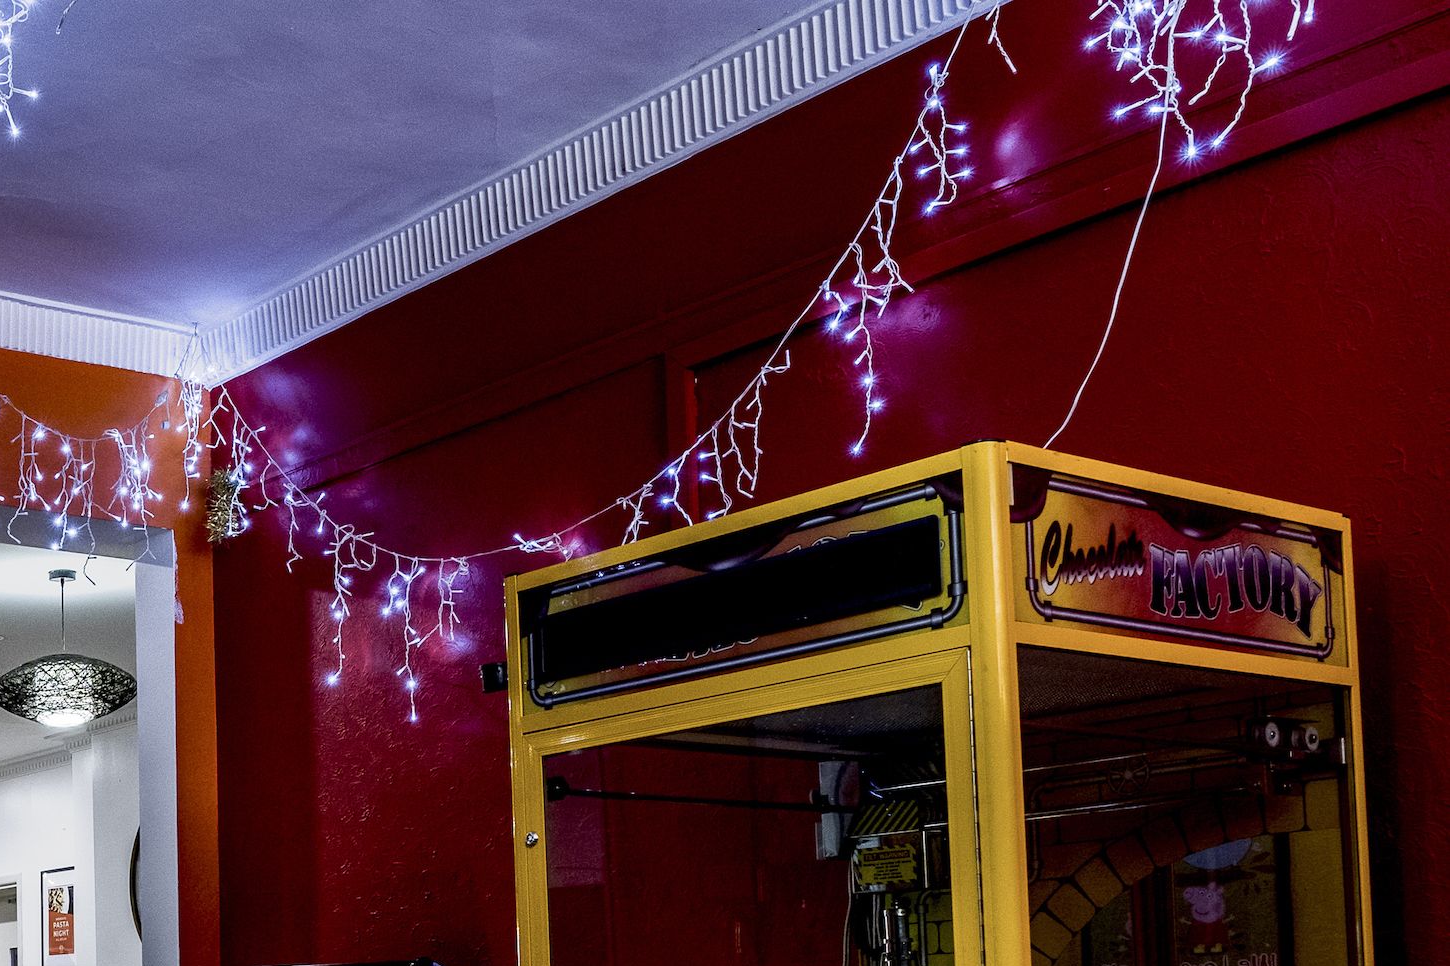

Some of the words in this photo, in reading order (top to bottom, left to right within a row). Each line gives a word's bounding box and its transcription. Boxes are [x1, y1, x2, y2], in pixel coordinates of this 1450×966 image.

[1040, 519, 1146, 596] Chocolate
[1149, 542, 1322, 640] FACTORY
[53, 920, 70, 929] PASTA
[53, 929, 69, 938] NIGHT
